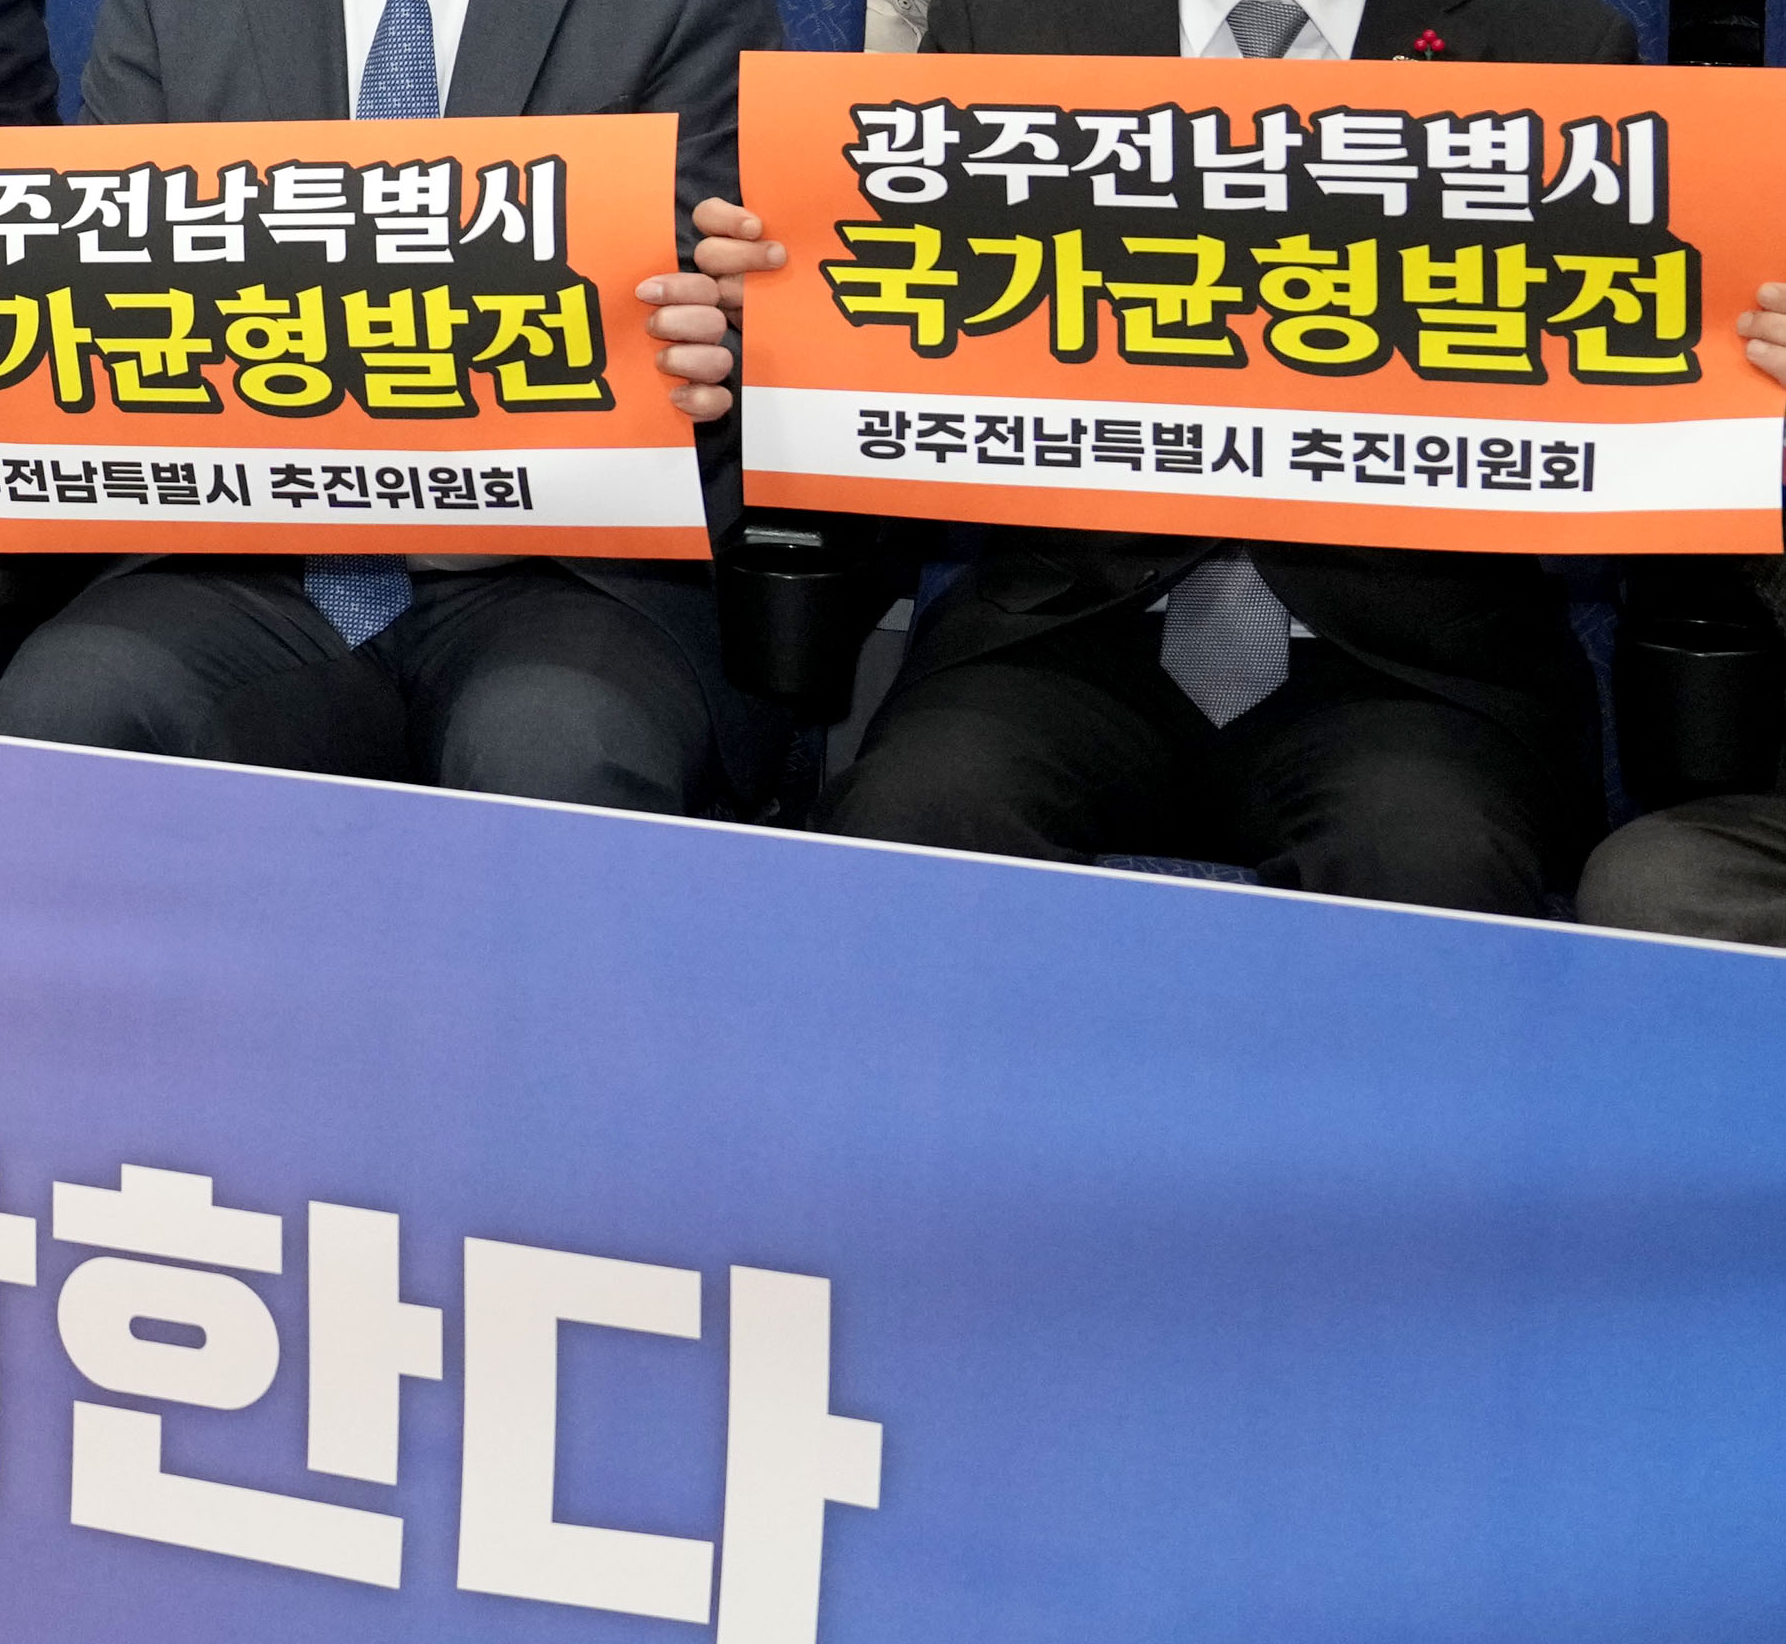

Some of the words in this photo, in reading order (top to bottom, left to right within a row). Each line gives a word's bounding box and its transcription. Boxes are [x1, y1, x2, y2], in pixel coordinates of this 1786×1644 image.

[849, 104, 1668, 226] 광주전남특별시
[826, 222, 1692, 376] 국가균형발전
[268, 461, 534, 511] 추진위원회
[855, 409, 1265, 479] 광주전남특별시
[1287, 426, 1596, 492] 추진위원회
